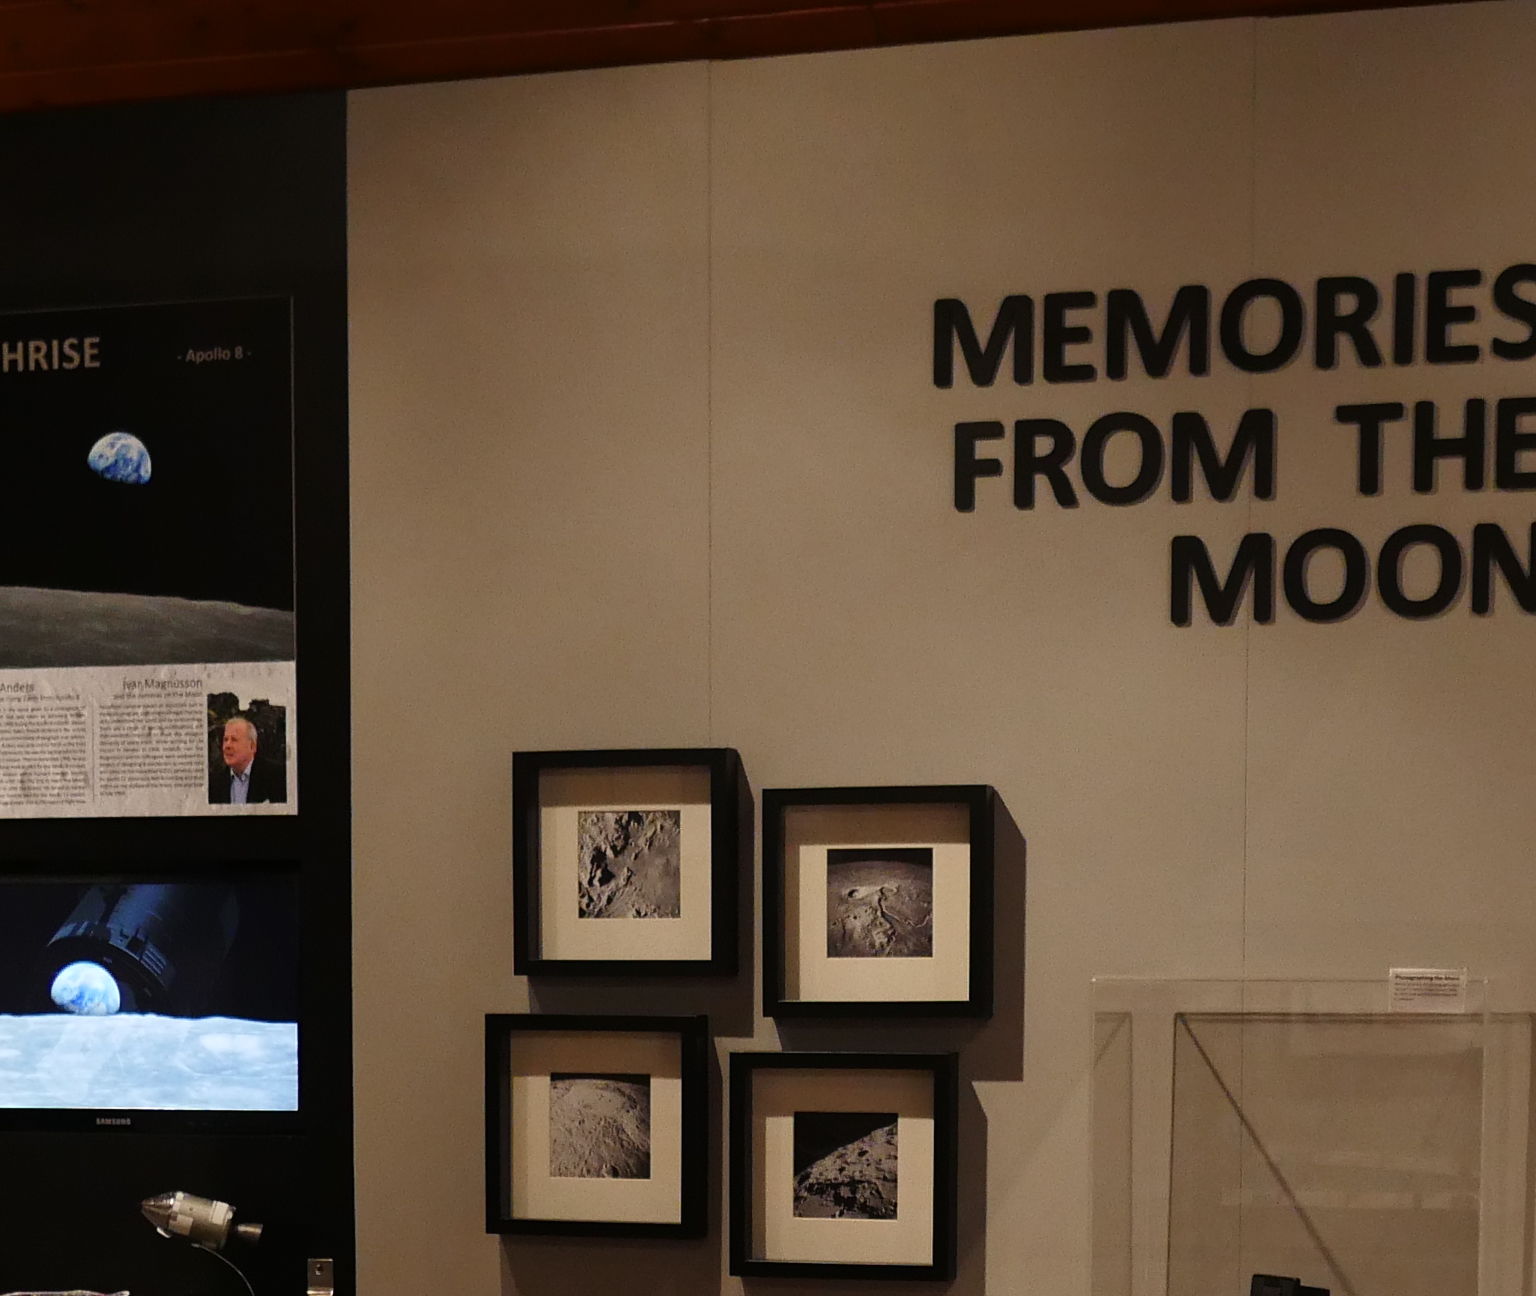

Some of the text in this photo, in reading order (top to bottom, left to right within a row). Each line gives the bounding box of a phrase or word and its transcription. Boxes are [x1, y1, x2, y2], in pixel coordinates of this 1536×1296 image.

[184, 348, 231, 365] Apollo
[234, 346, 244, 360] 8
[953, 409, 1274, 513] FROM
[144, 678, 203, 690] Magnusson
